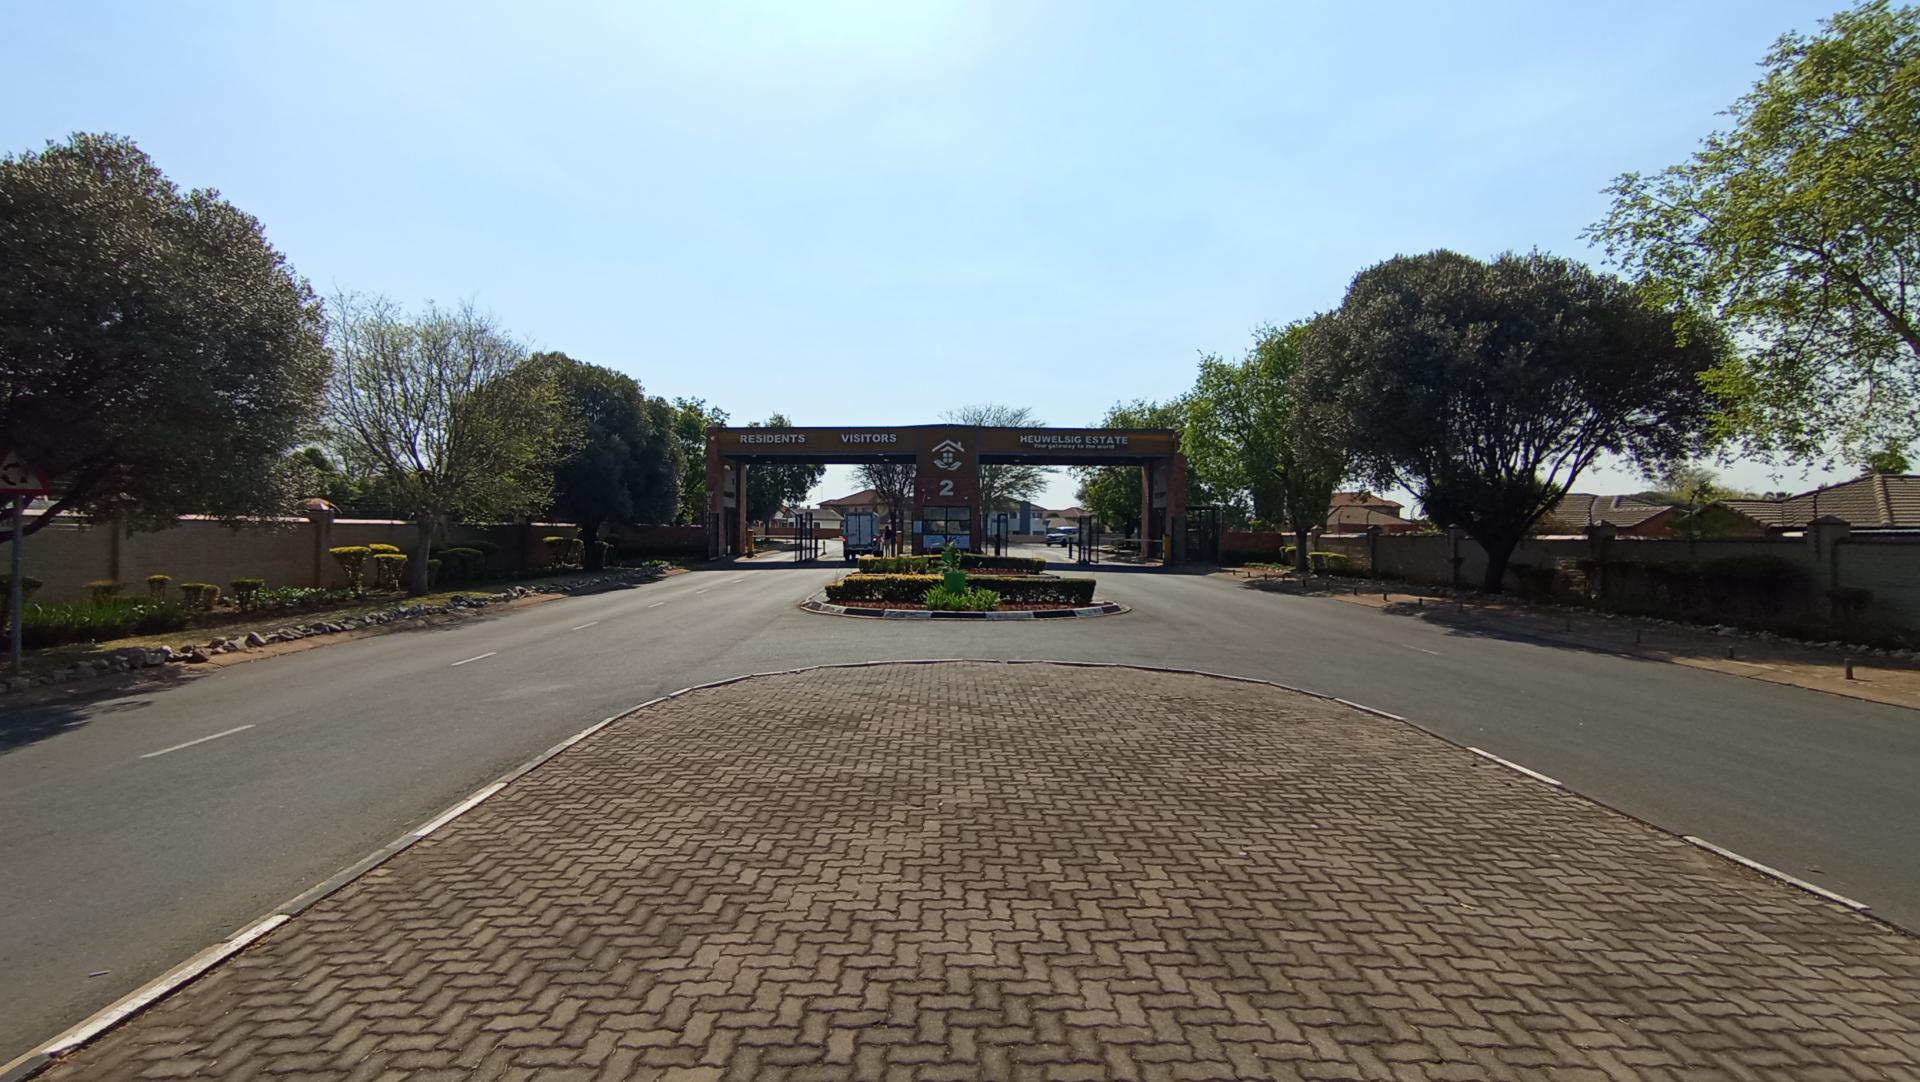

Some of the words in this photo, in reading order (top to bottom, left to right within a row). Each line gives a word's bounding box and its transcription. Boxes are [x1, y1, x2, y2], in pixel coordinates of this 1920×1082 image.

[740, 434, 805, 443] RESIDENTS
[841, 433, 897, 443] VISITORS
[1020, 435, 1081, 443] HEUWELSIG
[1085, 435, 1128, 444] ESTATE
[939, 479, 954, 496] 2
